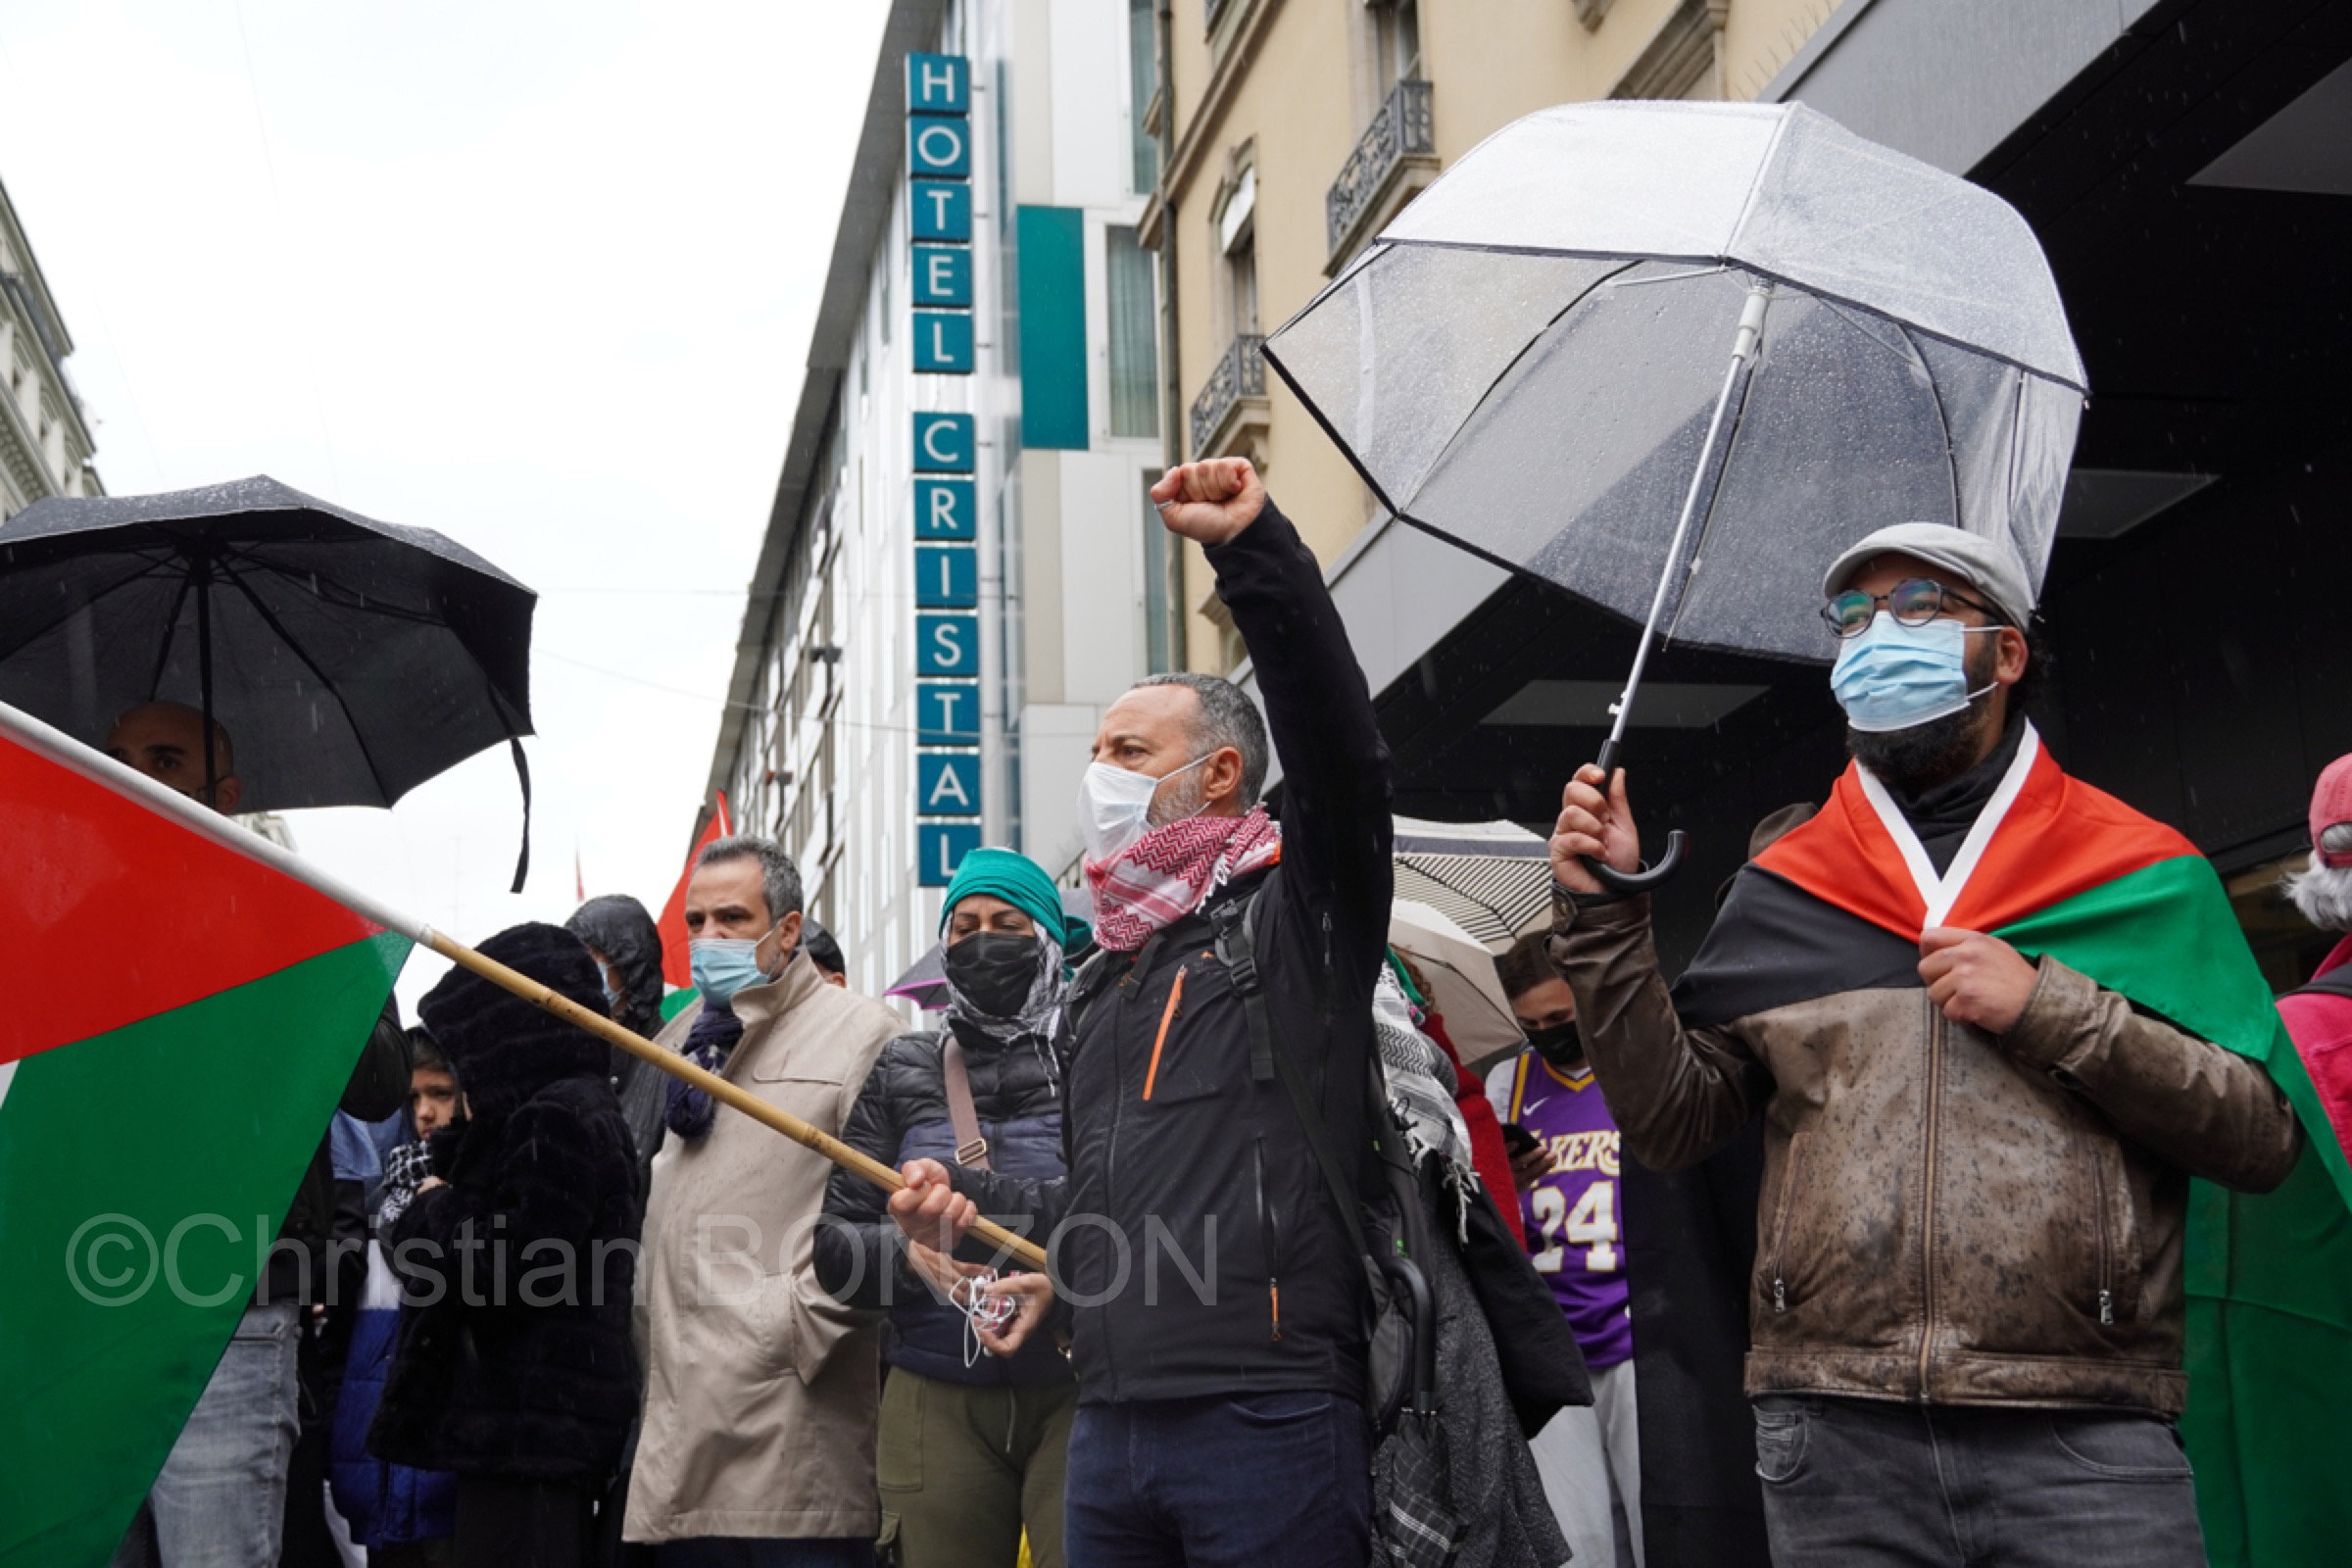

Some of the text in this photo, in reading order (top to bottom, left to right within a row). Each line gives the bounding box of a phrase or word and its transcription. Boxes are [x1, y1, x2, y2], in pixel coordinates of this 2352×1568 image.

[916, 63, 969, 877] HOTEL CRISTAL
[1529, 1129, 1621, 1177] KERS
[1532, 1180, 1618, 1272] 24
